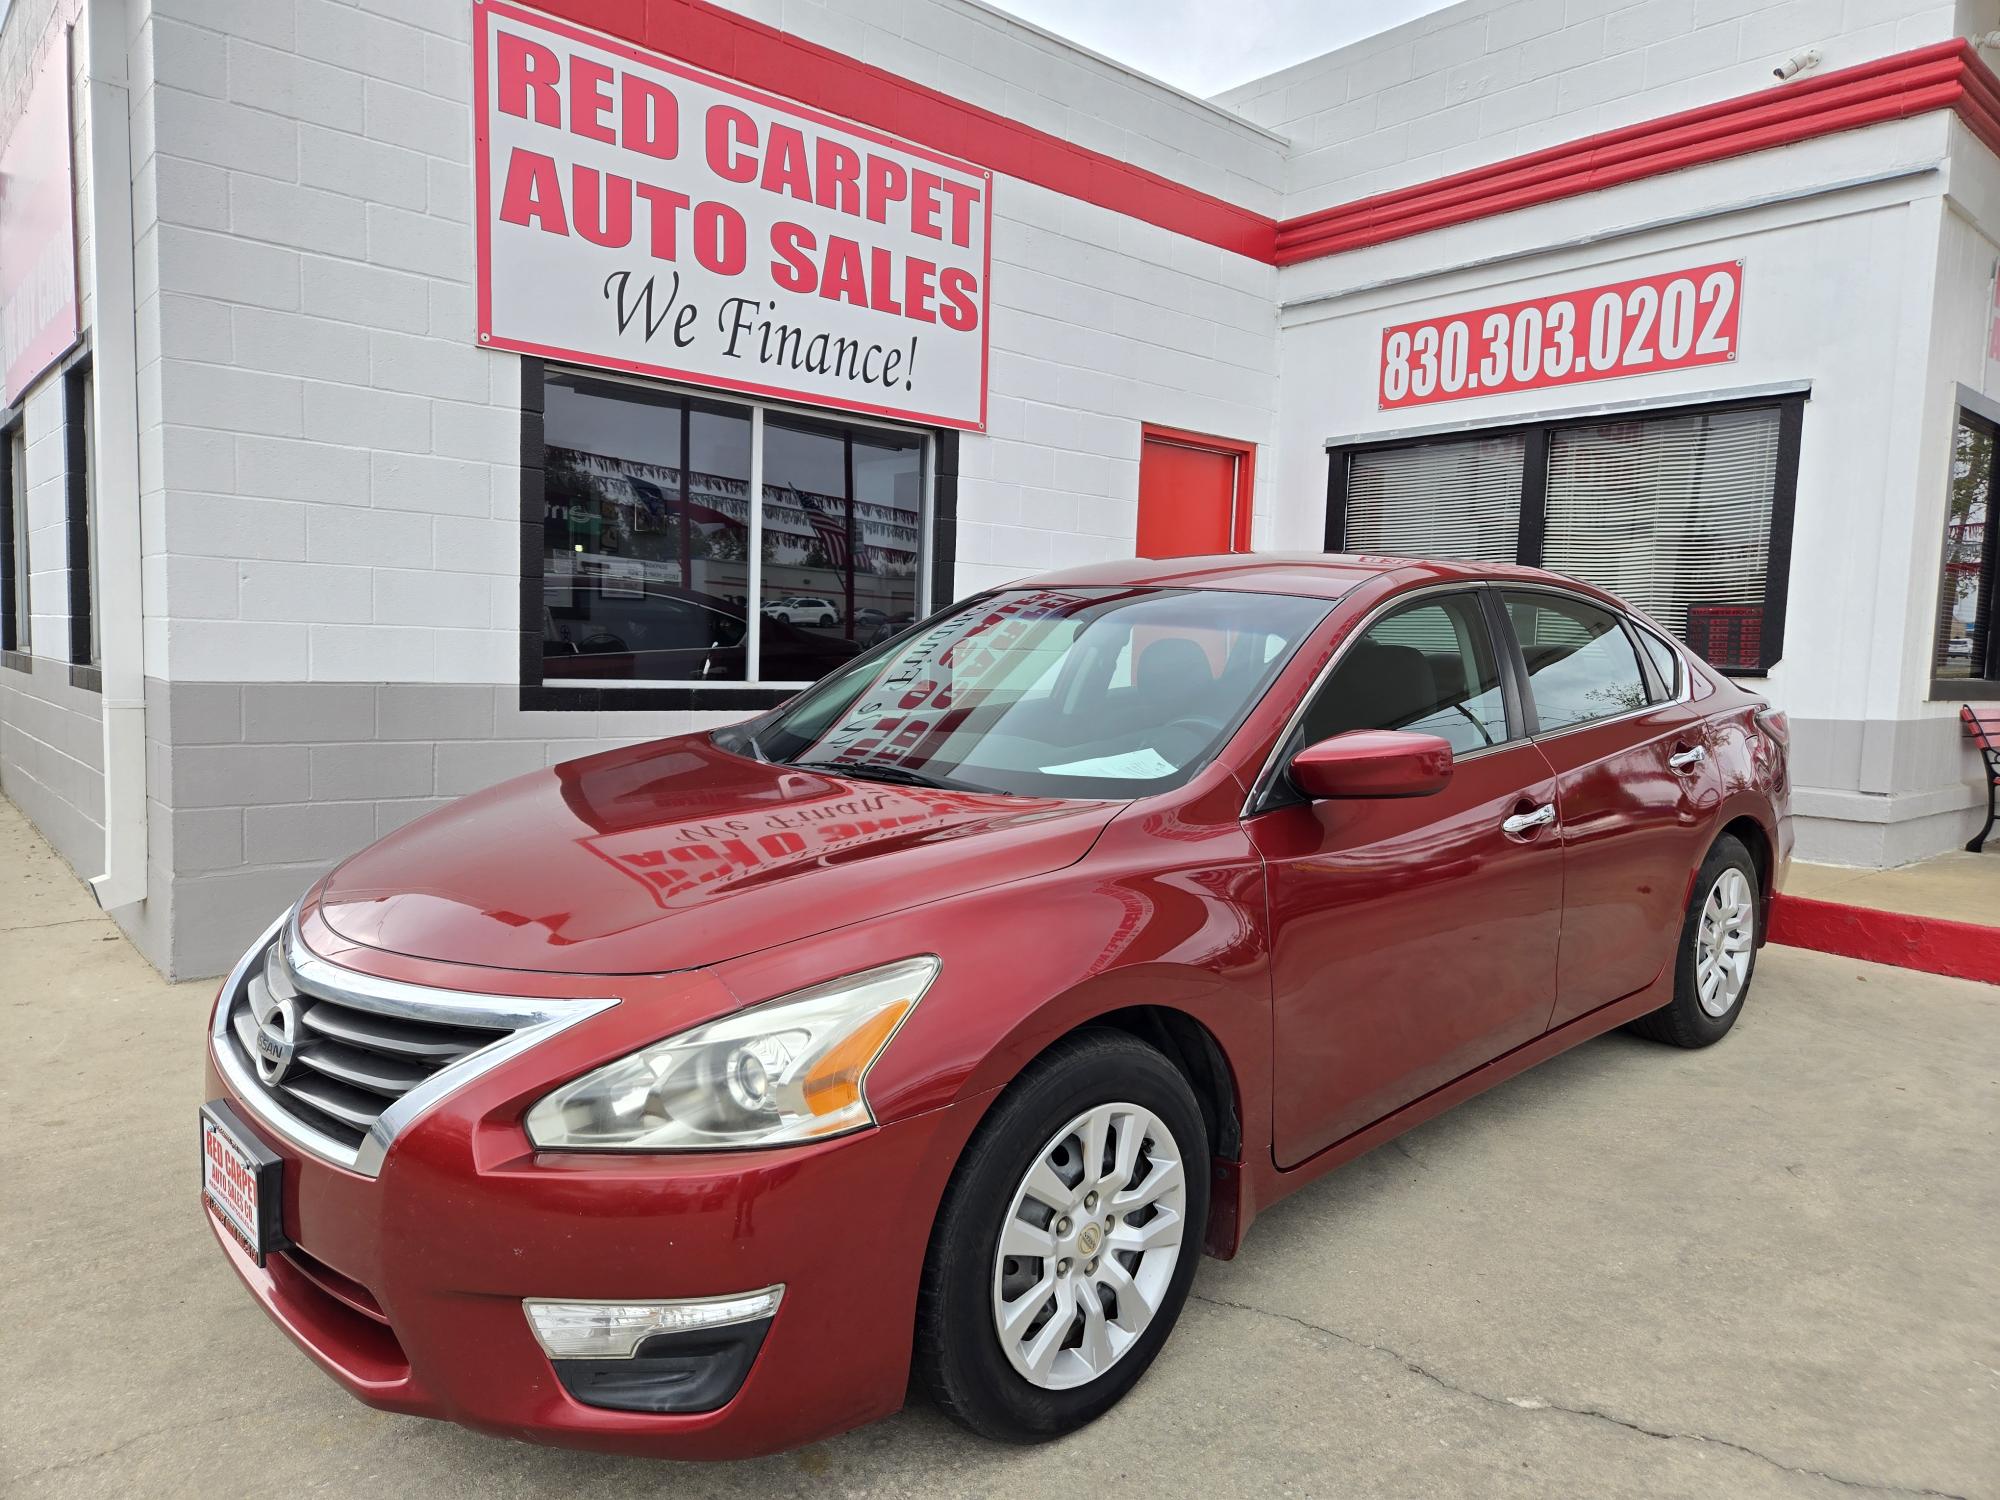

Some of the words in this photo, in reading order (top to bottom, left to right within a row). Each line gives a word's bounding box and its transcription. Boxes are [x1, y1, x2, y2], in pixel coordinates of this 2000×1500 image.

[497, 30, 679, 161] RED
[705, 104, 981, 248] CARPET
[499, 146, 747, 276] AUTO
[770, 221, 979, 332] SALES
[603, 271, 698, 348] We
[718, 297, 918, 391] Finance!
[1383, 272, 1735, 401] 830.303.0202
[207, 1130, 223, 1168] RED
[225, 1150, 257, 1208] CARPET
[212, 1163, 226, 1192] AUTO
[228, 1178, 243, 1213] SALES
